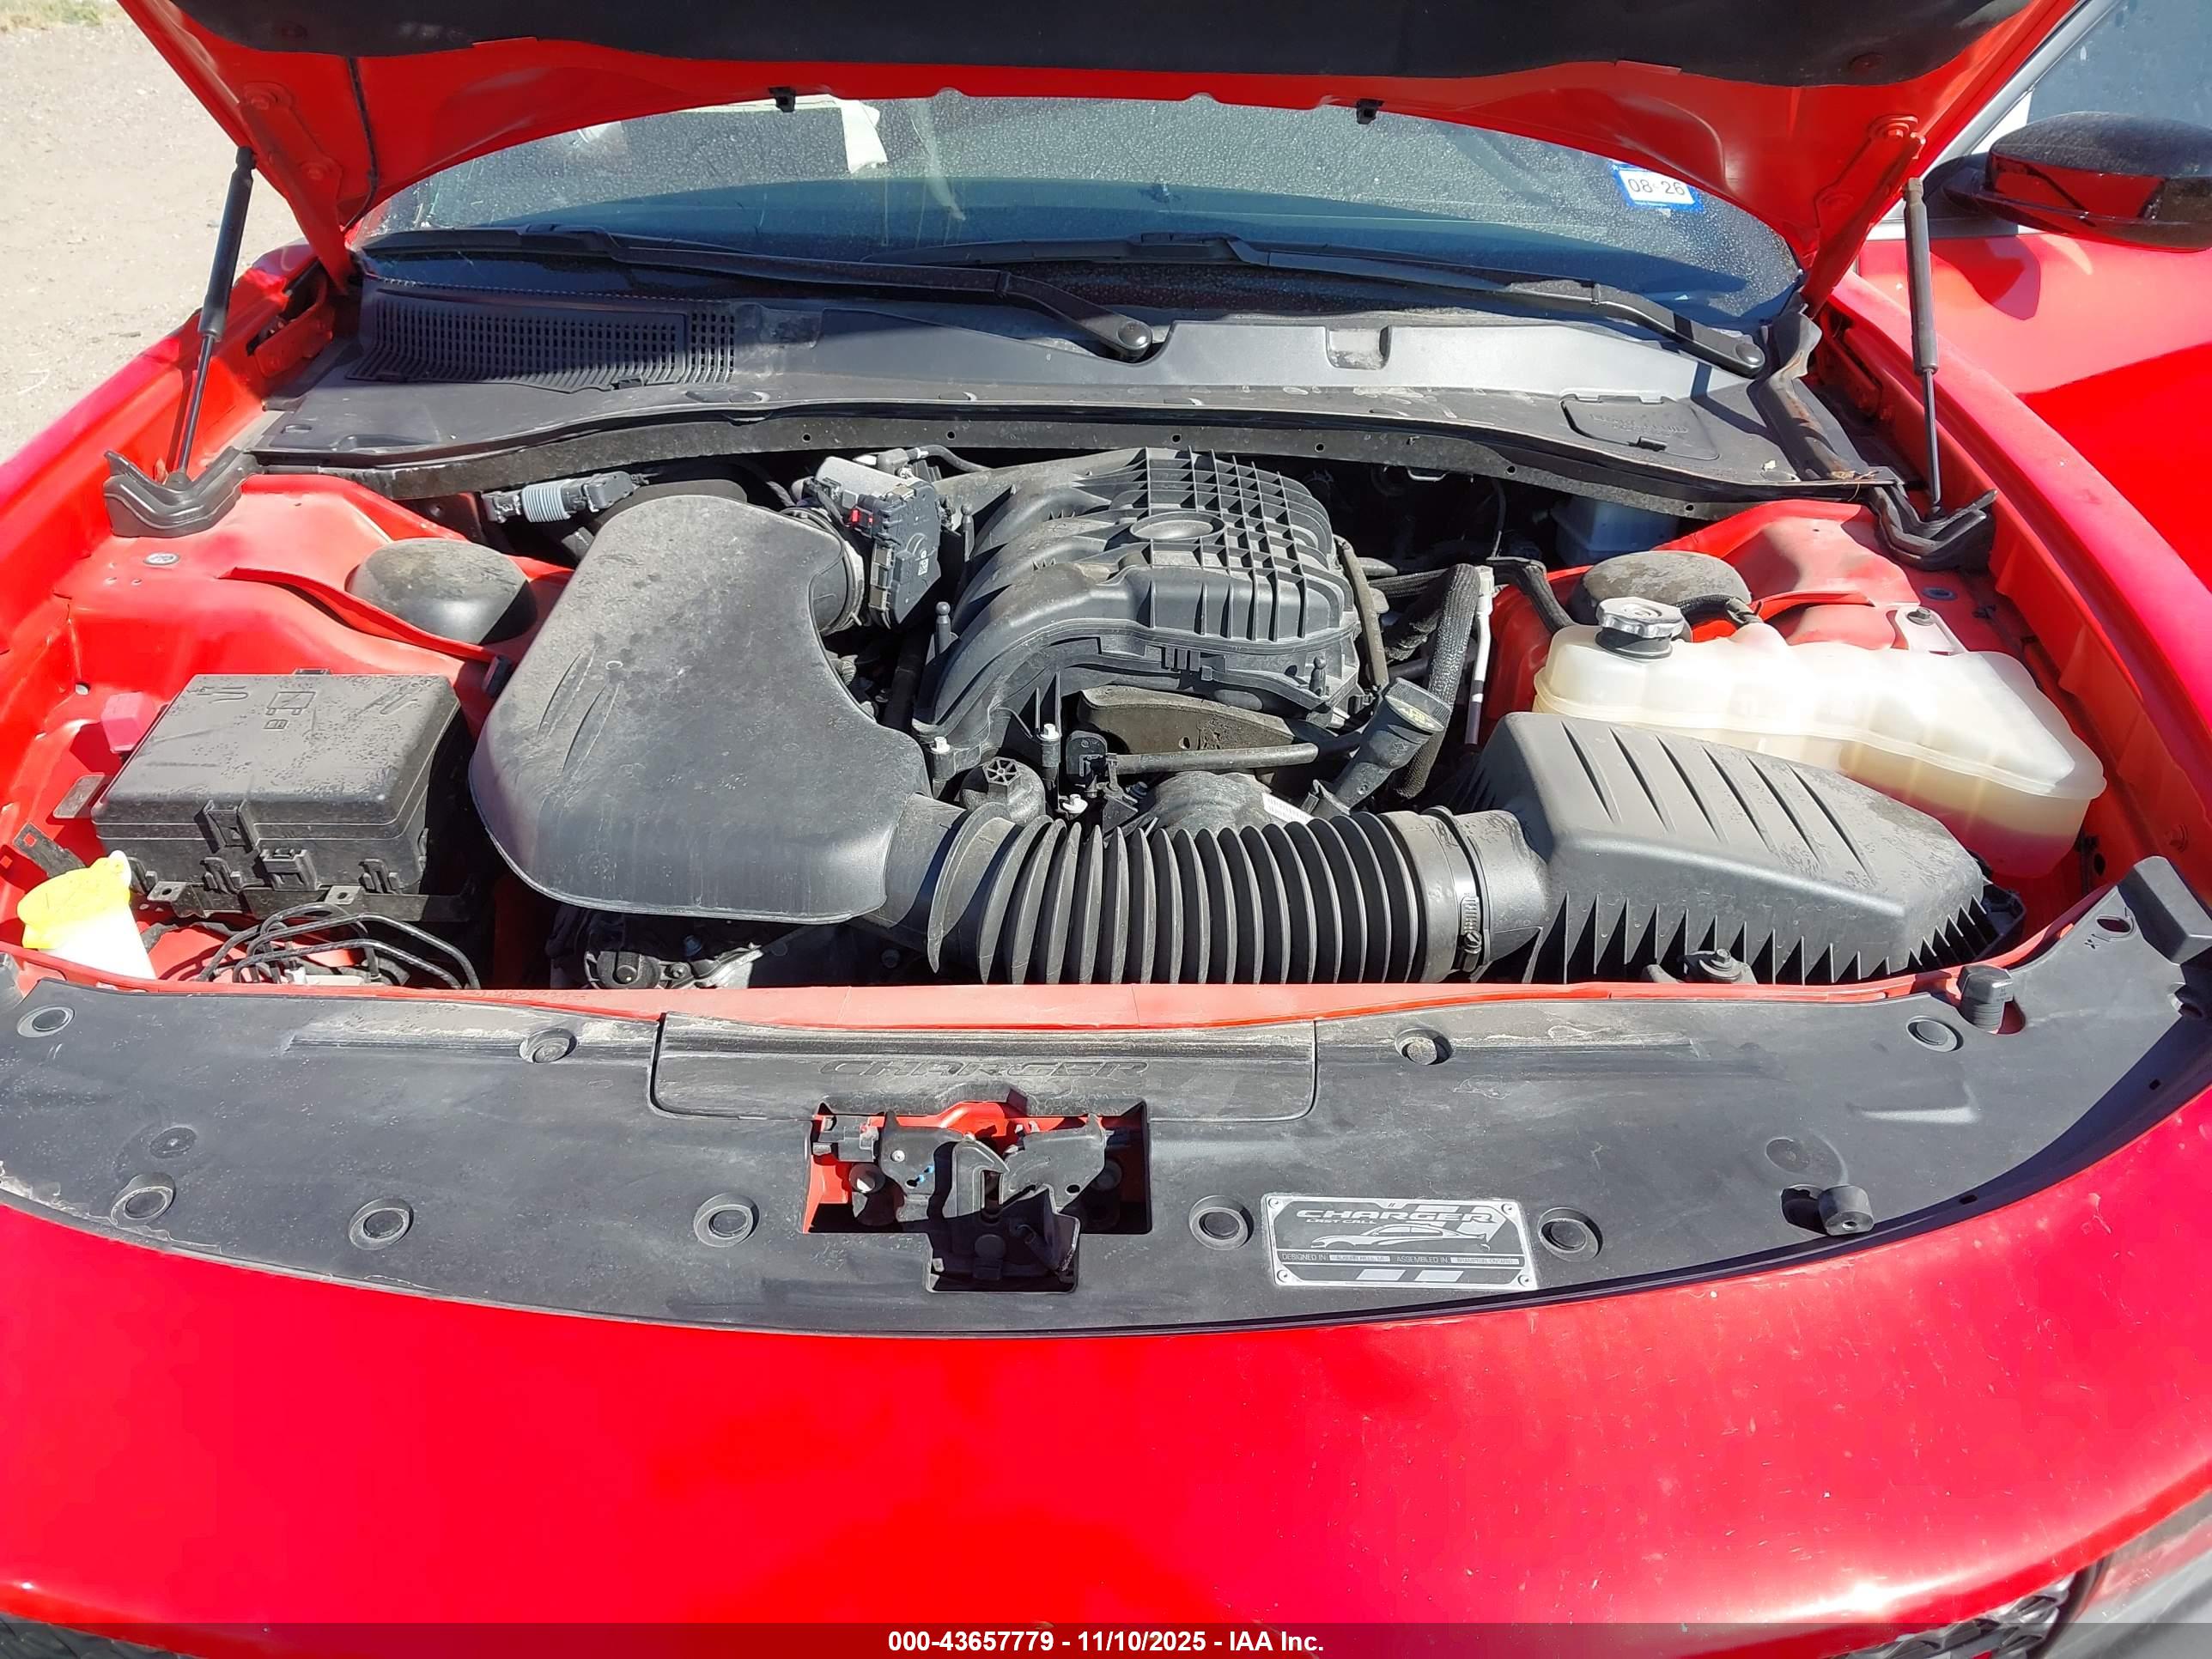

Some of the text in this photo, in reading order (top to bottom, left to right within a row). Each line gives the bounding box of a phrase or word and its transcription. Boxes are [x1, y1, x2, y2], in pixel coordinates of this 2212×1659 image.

[1628, 179, 1686, 196] 08 26
[819, 1060, 1151, 1077] CHARGER
[1297, 1209, 1496, 1224] CHARGER
